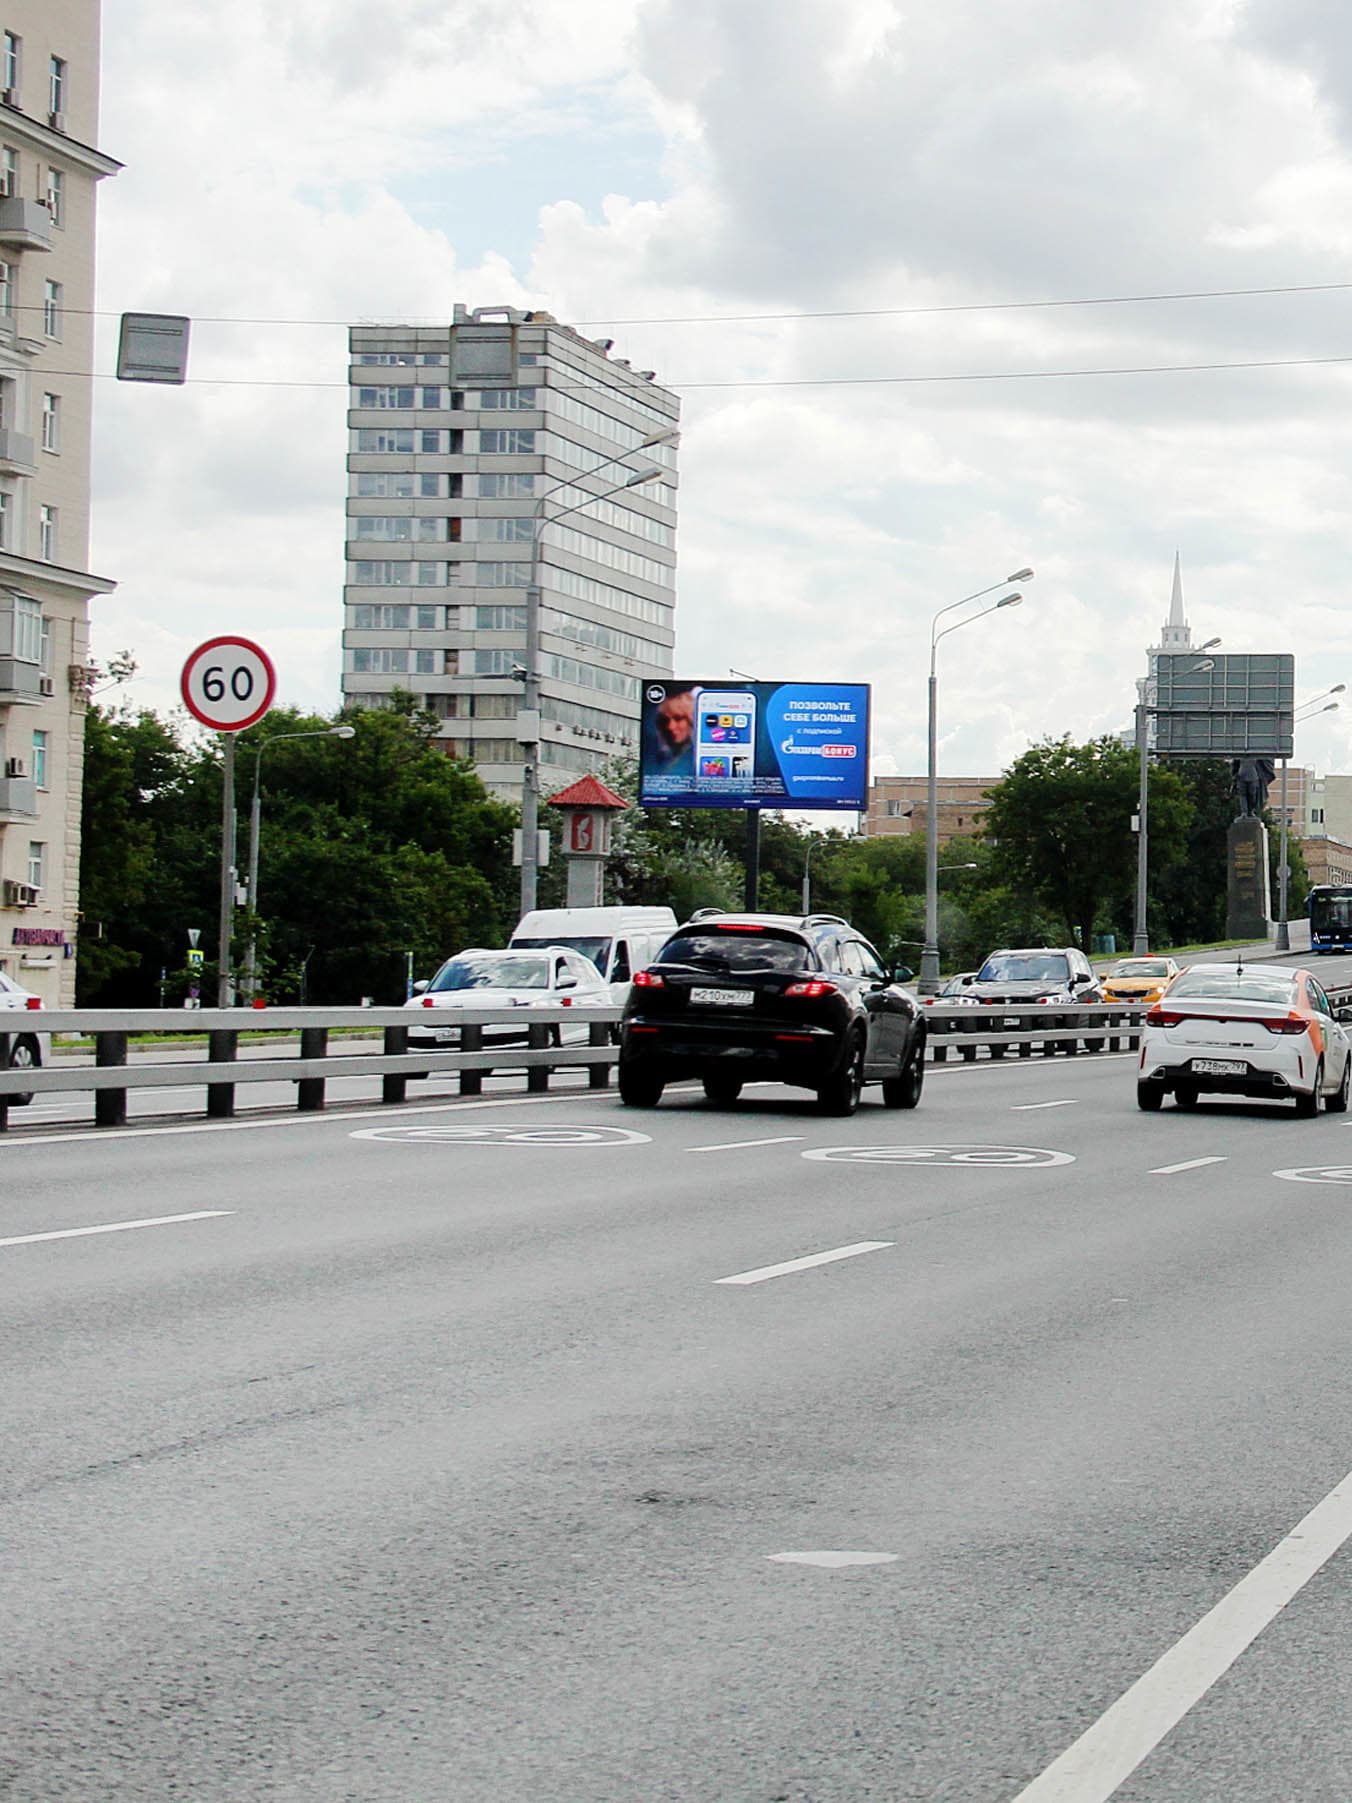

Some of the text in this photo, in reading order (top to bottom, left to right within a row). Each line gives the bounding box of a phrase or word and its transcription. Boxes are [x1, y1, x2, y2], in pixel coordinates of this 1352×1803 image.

[202, 666, 254, 702] 60
[789, 701, 851, 711] ПОЗВОЛЬТЕ
[784, 713, 857, 723] СЕБЕ БОЛЬШЕ
